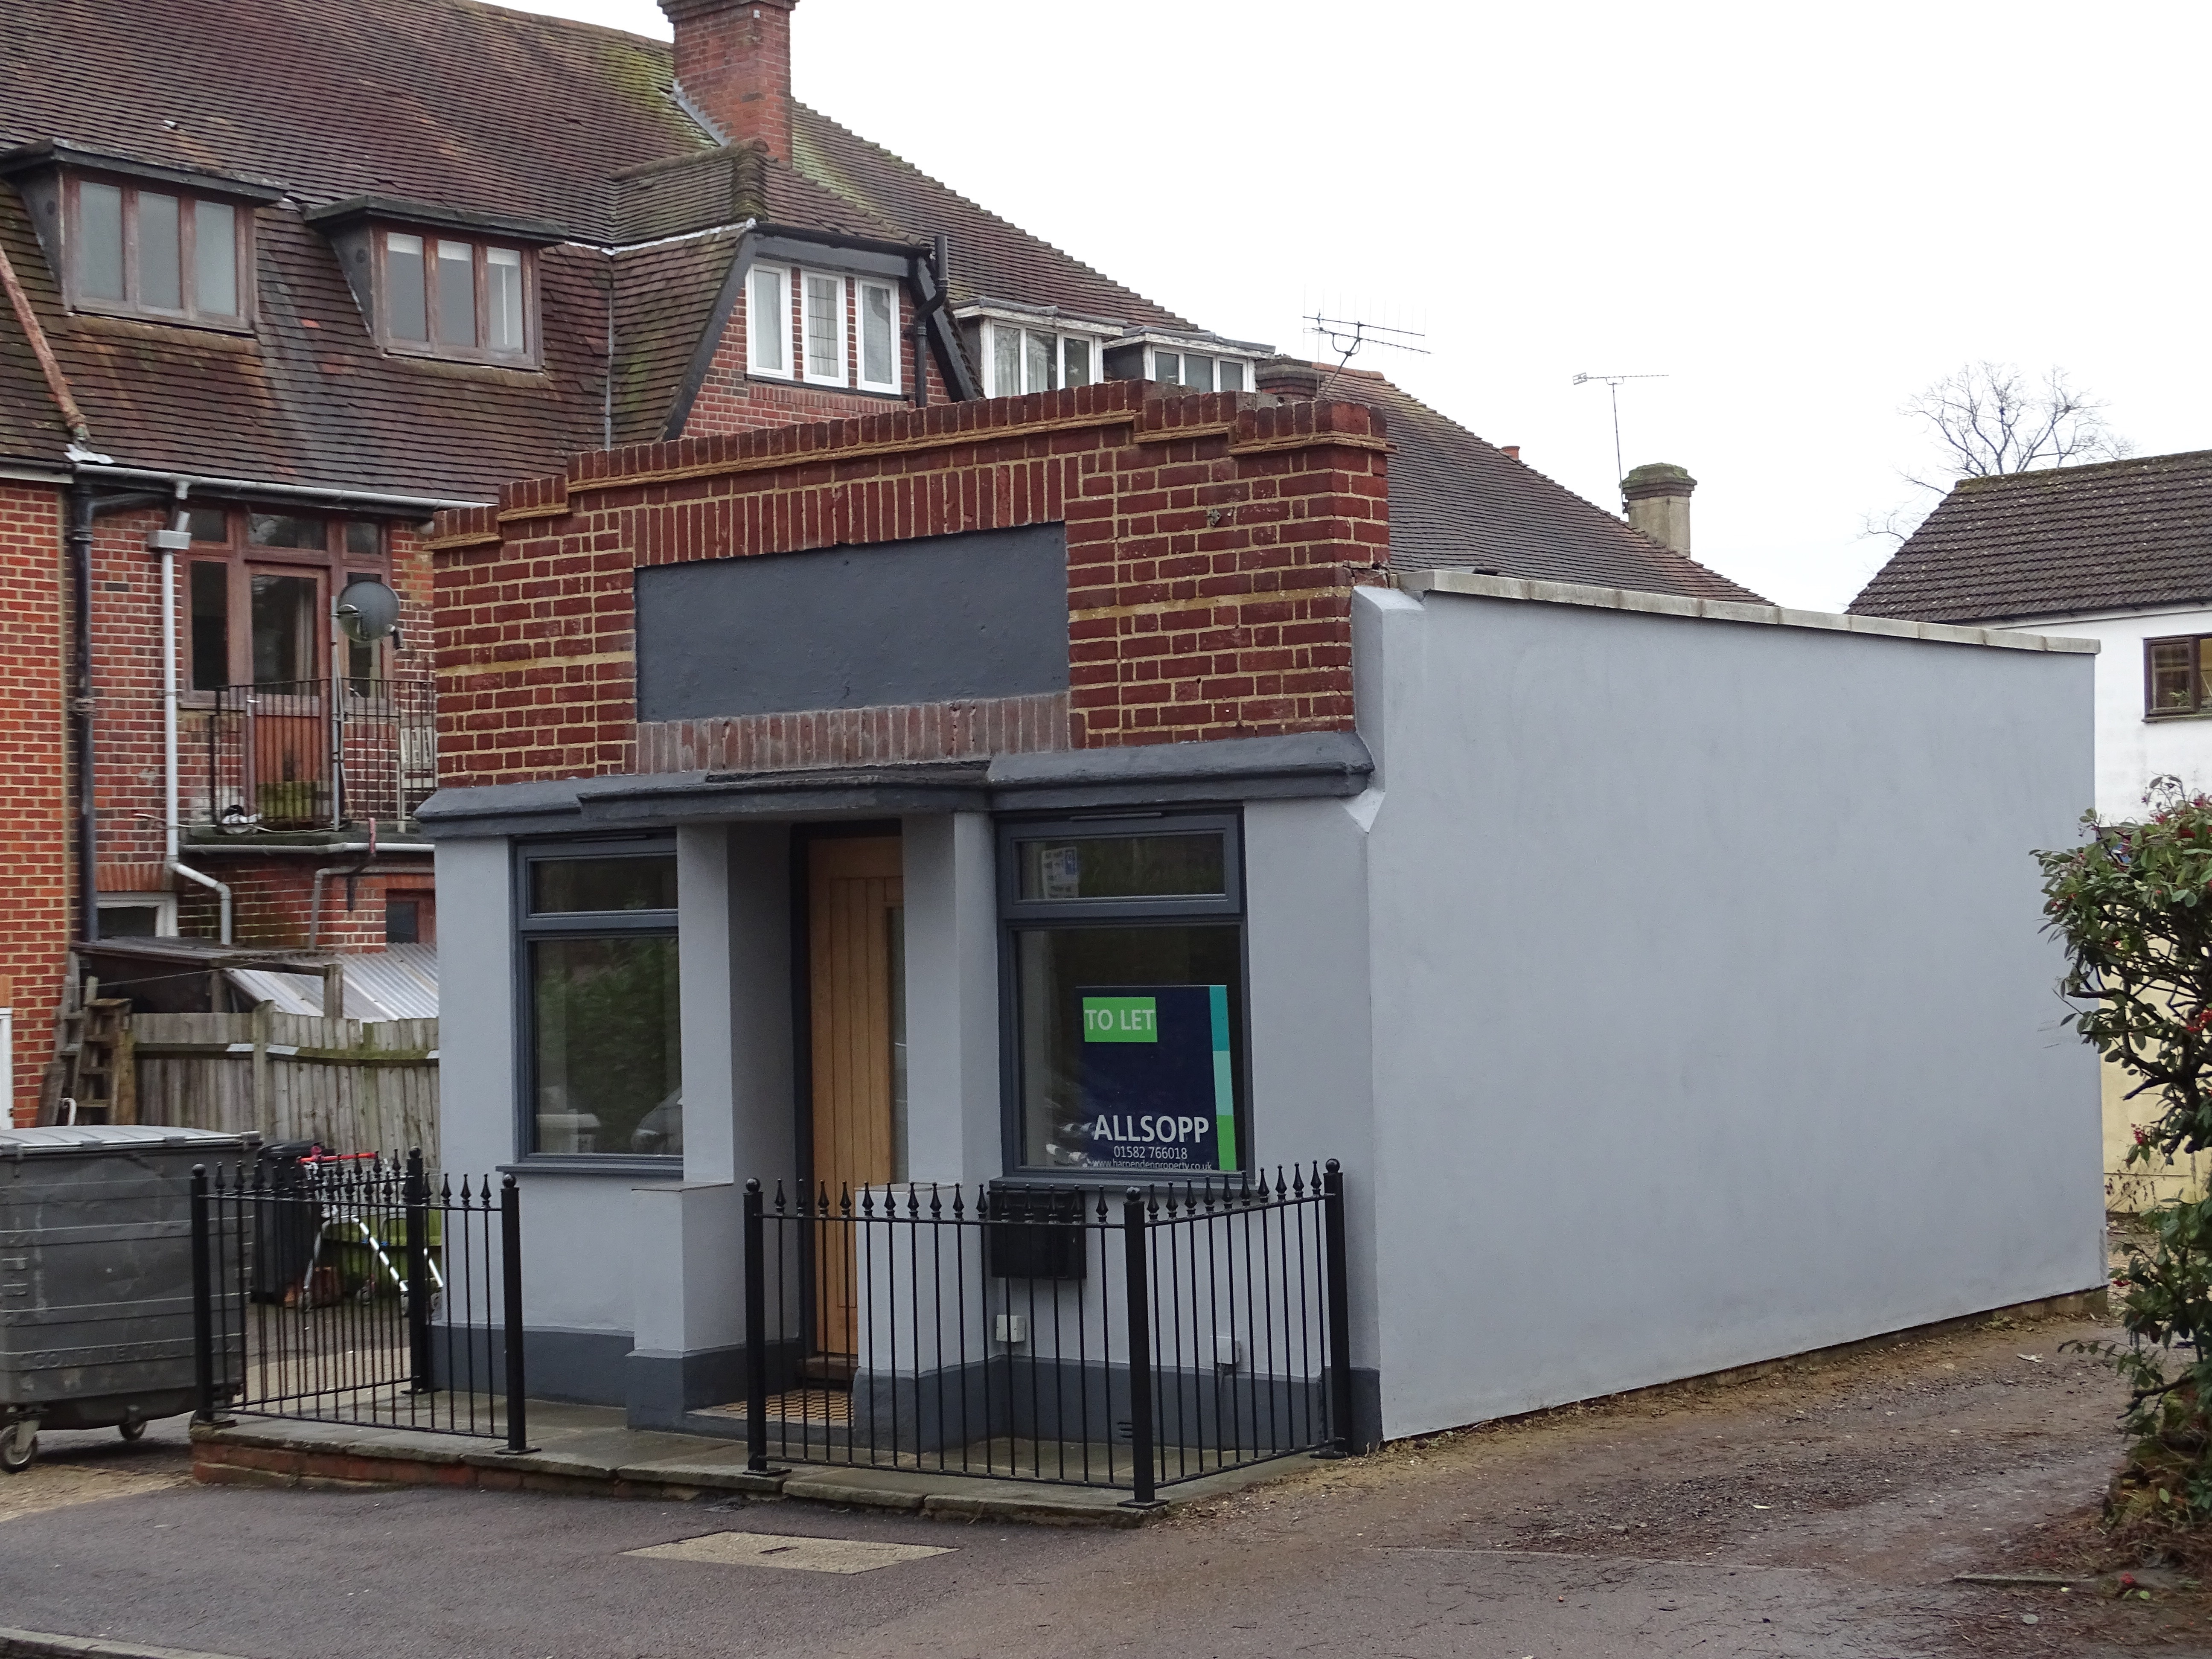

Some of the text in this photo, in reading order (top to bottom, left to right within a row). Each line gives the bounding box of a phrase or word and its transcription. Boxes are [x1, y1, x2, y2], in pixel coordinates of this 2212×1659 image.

[1085, 1009, 1155, 1030] TO LET
[1094, 1115, 1209, 1143] ALLSOPP
[1114, 1146, 1187, 1159] 01582 766018
